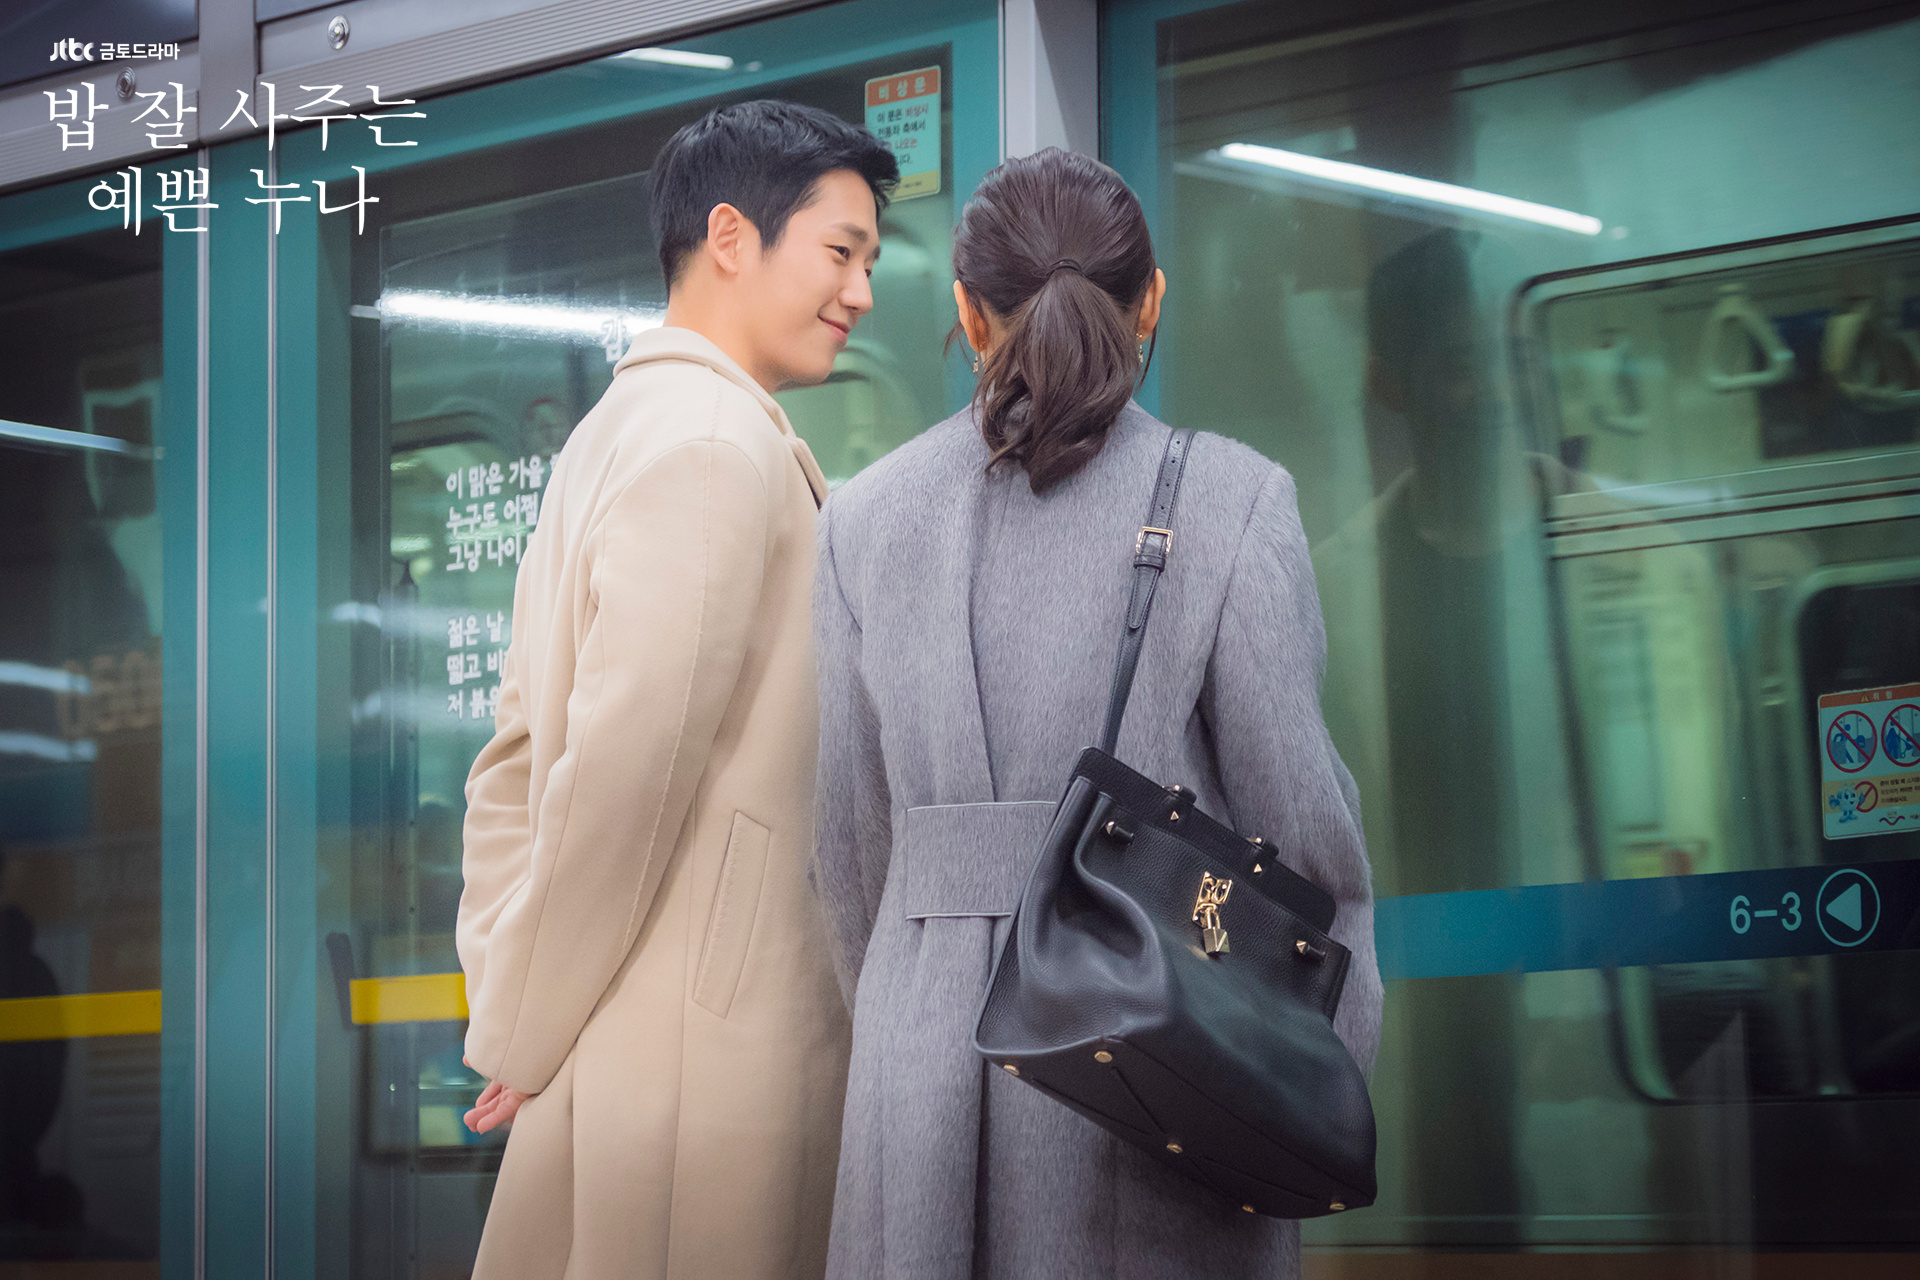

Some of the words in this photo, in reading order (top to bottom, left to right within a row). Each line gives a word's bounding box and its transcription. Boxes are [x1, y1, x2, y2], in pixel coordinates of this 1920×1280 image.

[446, 467, 463, 499] 이
[468, 461, 504, 499] 맑은
[508, 454, 545, 490] 가을
[446, 501, 499, 536] 누구도
[446, 537, 482, 572] 그냥
[487, 533, 521, 567] 나이
[446, 614, 480, 649] 젊은
[486, 610, 504, 643] 날
[446, 652, 482, 685] 떫고
[447, 689, 463, 719] 저
[1730, 891, 1802, 934] 6-3
